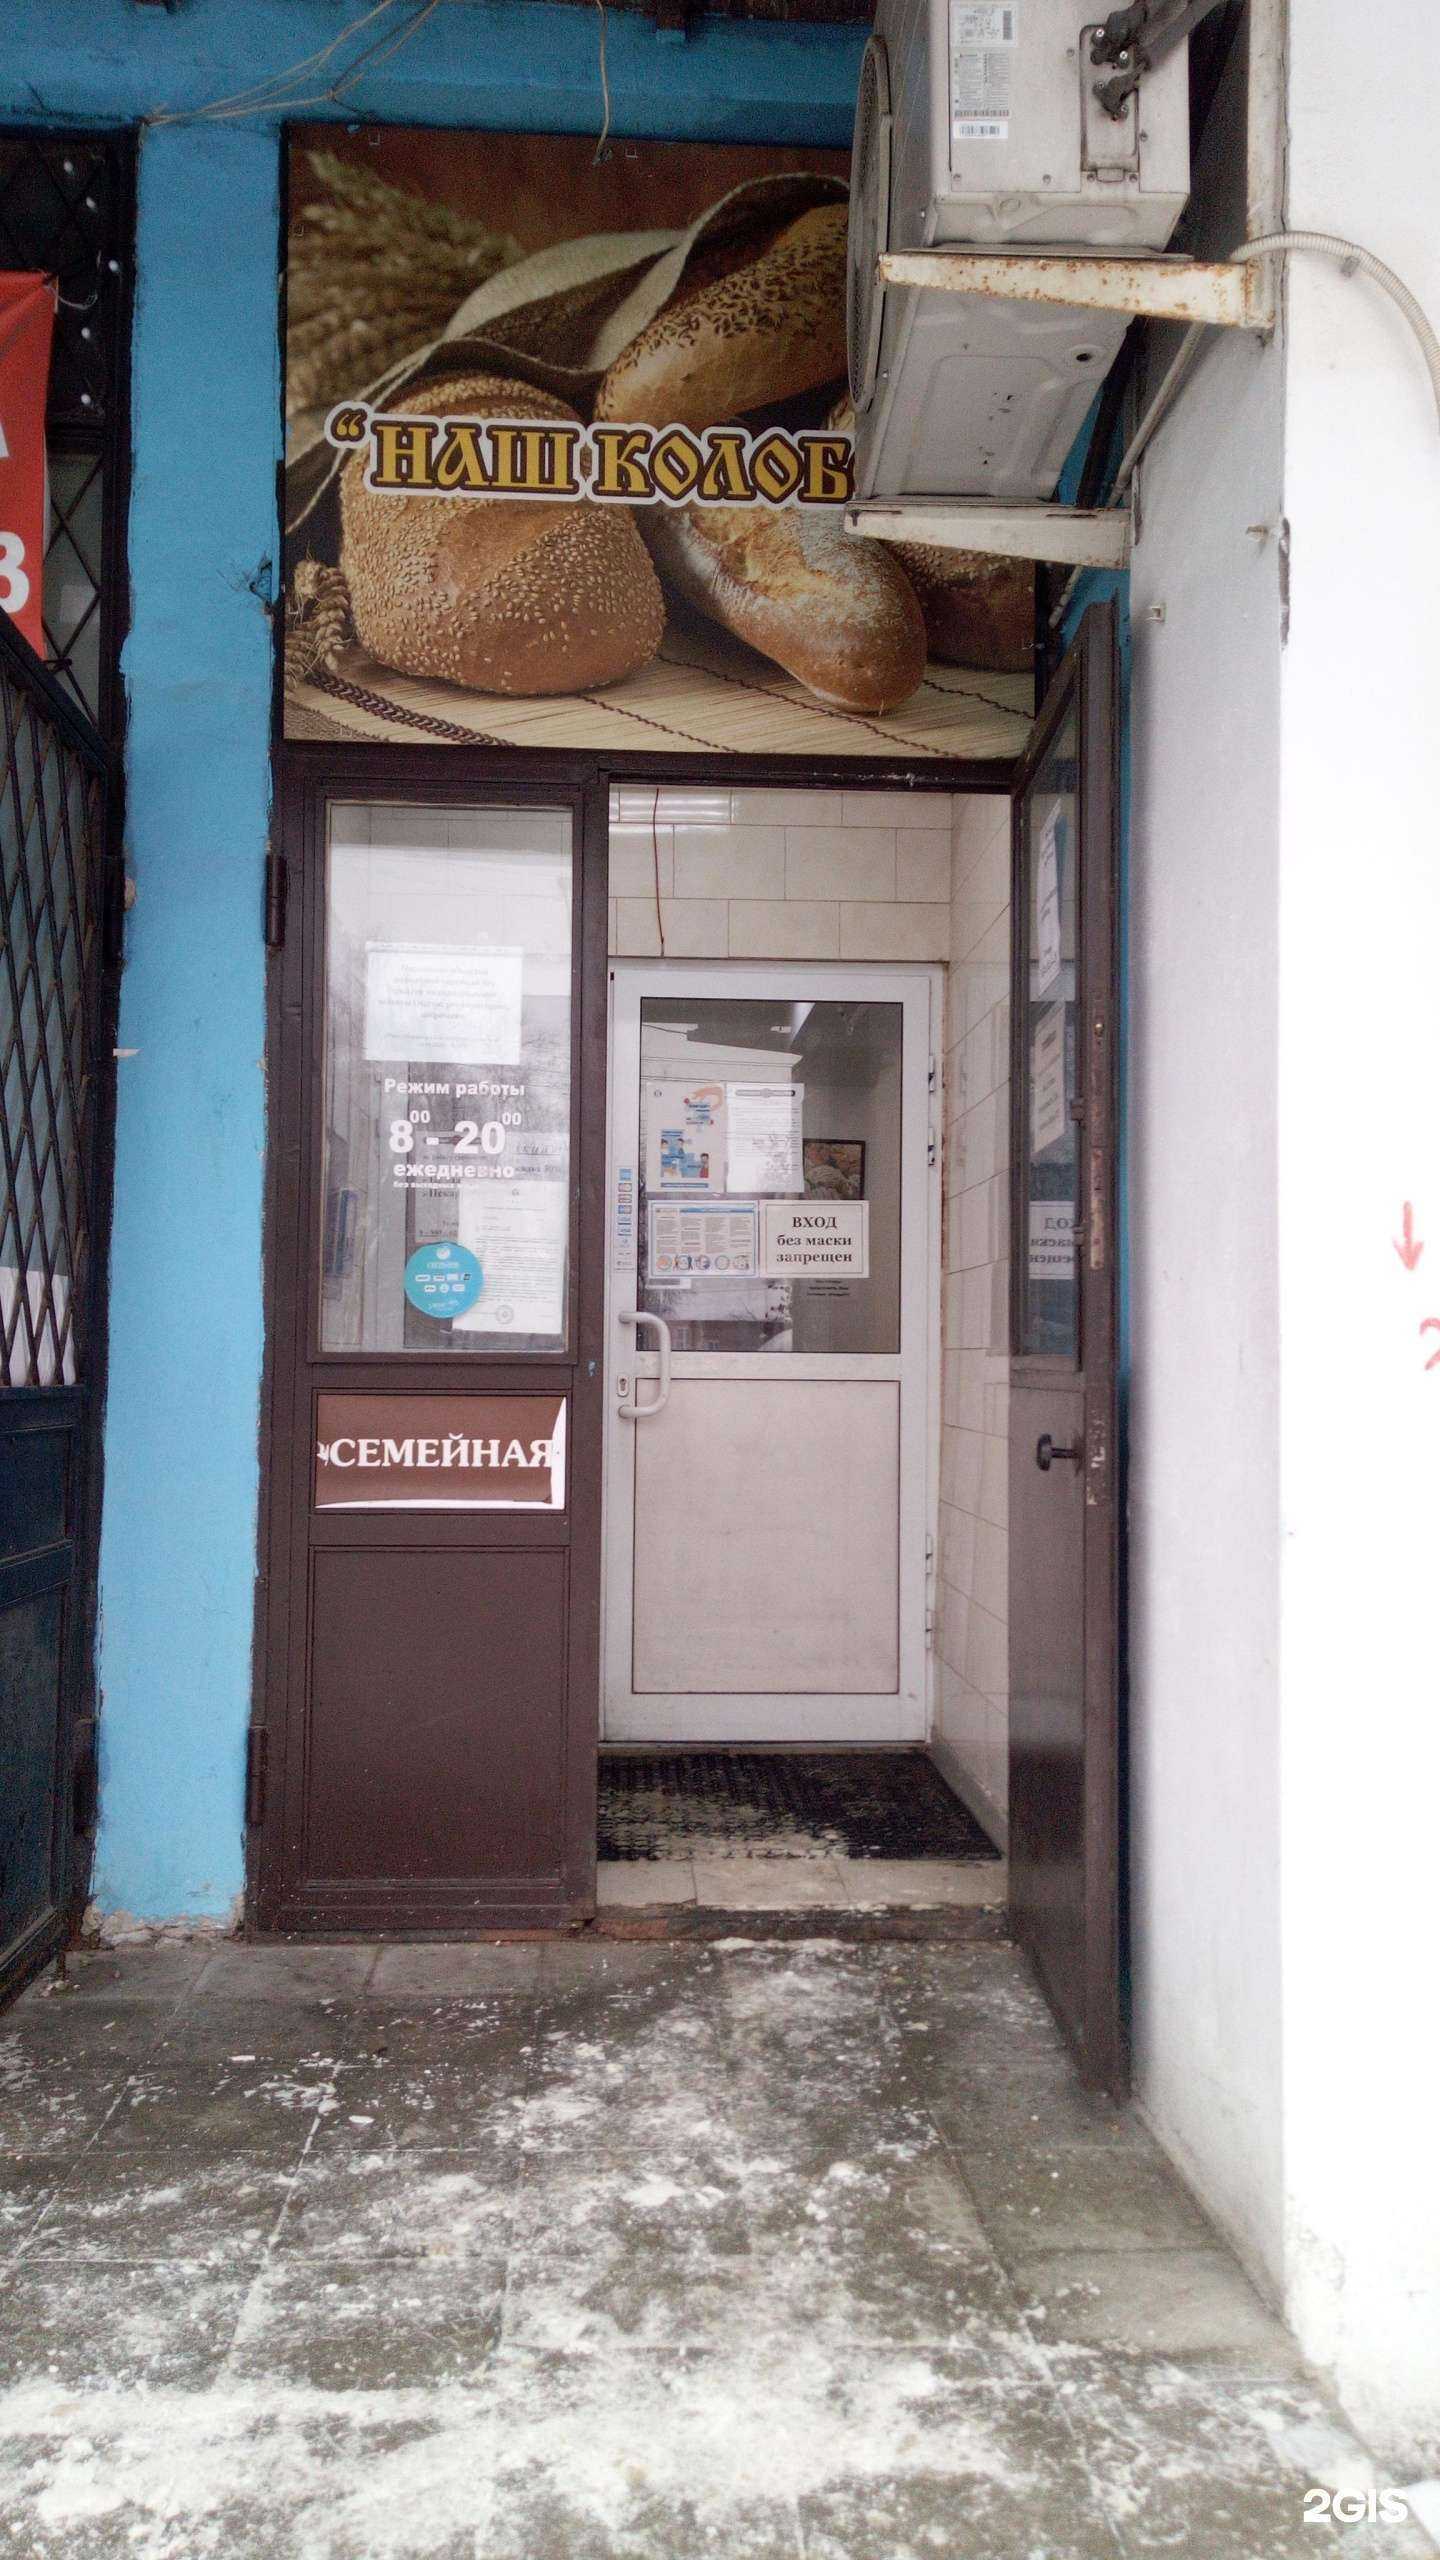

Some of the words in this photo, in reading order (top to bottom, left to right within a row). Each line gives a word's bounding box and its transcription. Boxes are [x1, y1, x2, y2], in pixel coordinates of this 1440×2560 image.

[593, 427, 856, 503] КОЛОБ
[384, 1079, 449, 1095] Режим
[456, 1081, 525, 1098] работы
[393, 1164, 515, 1179] ежедневно
[792, 1216, 838, 1230] ВХОД
[777, 1234, 801, 1246] без
[806, 1237, 852, 1246] маски
[776, 1253, 852, 1265] запрещен
[330, 1433, 553, 1467] СЕМЕЙНАЯ
